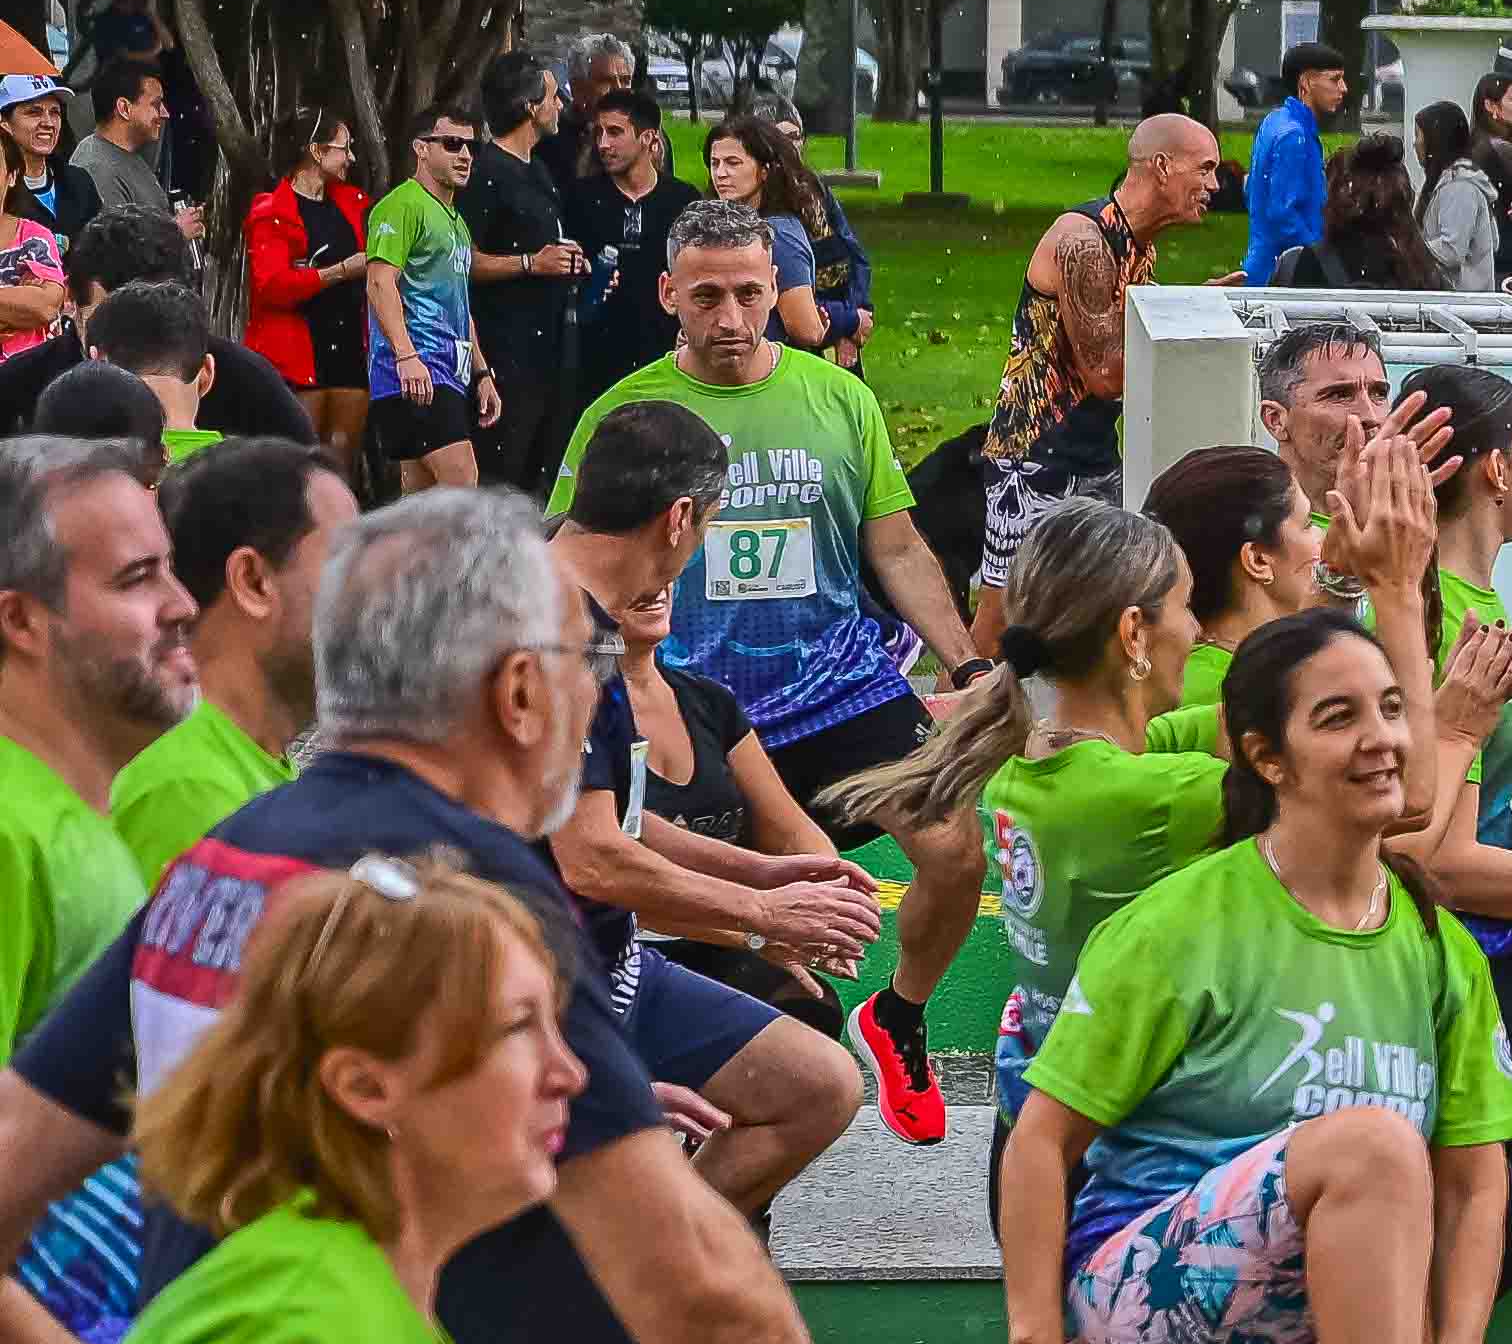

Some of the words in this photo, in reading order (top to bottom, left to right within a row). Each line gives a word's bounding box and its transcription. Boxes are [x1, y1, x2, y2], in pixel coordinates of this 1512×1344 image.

[767, 448, 823, 483] Ville
[729, 528, 789, 580] 87
[1371, 1041, 1435, 1101] Ville
